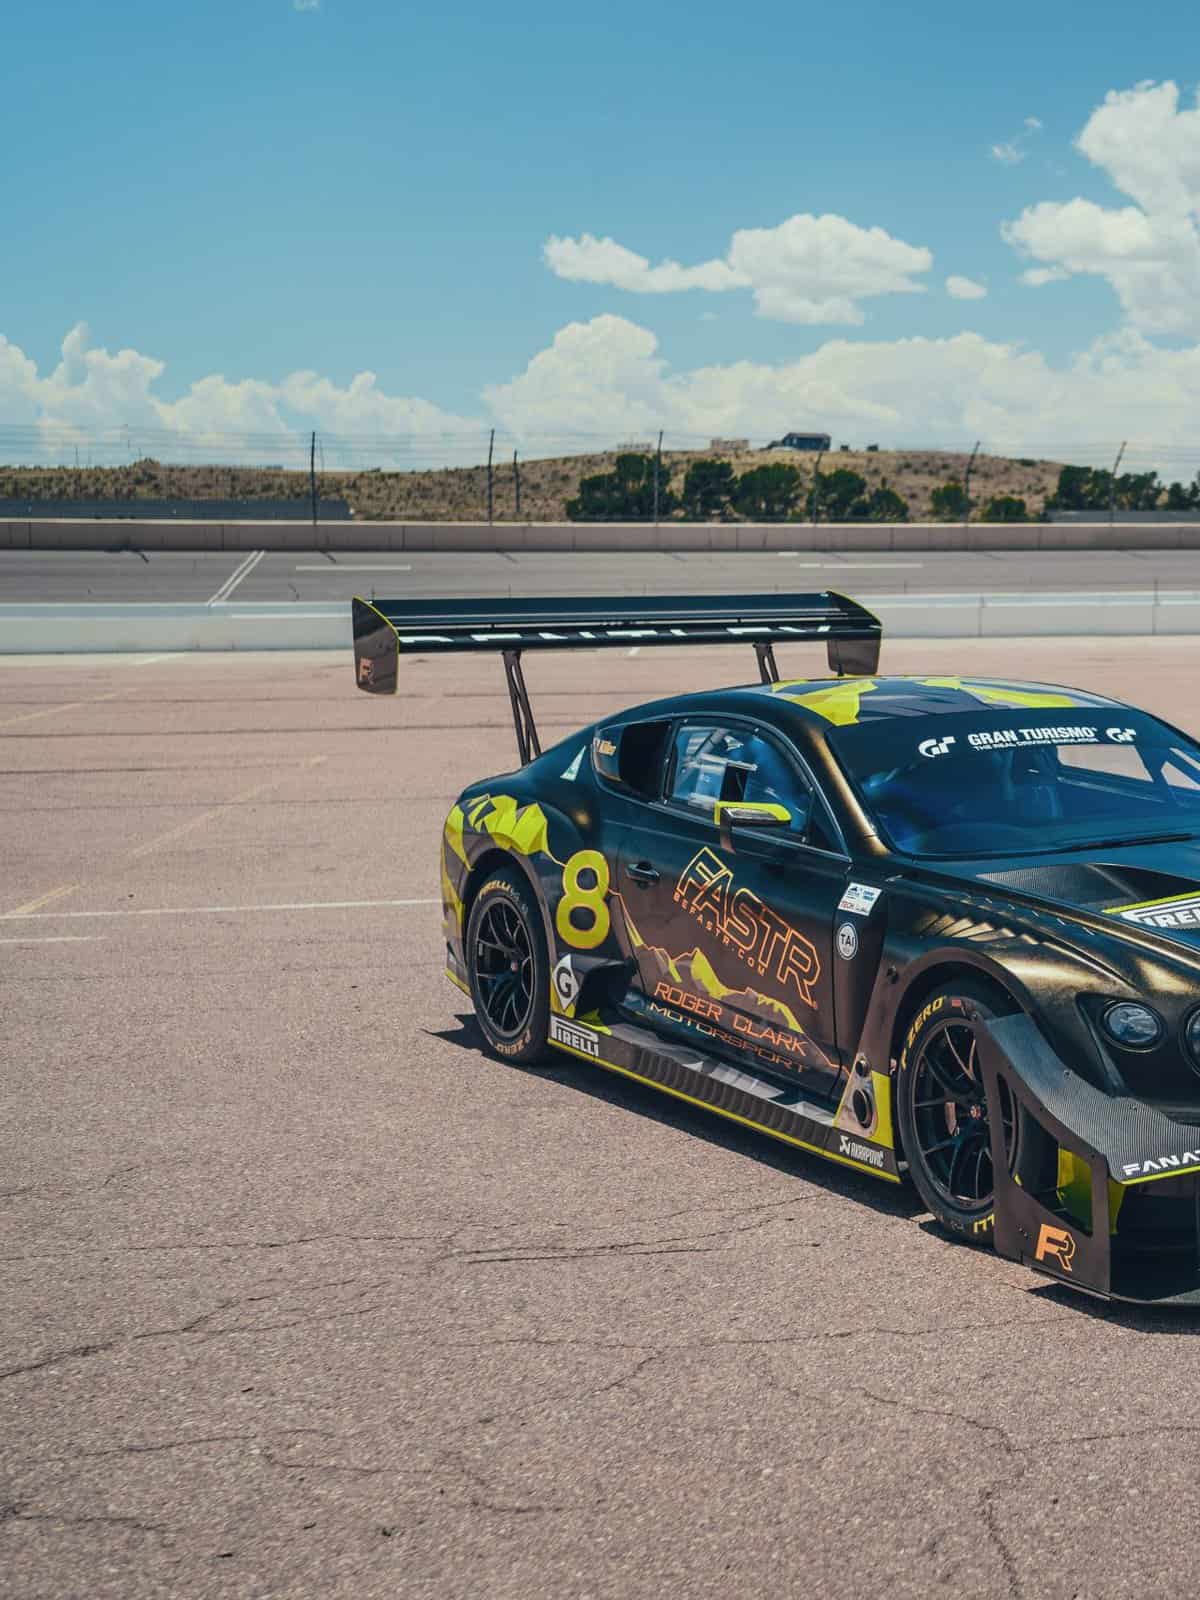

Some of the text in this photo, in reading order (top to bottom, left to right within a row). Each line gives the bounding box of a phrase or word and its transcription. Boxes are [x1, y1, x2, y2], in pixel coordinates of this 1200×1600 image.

[968, 727, 1094, 746] GRAN TURISMO
[557, 850, 609, 949] 8
[676, 846, 820, 1008] FASTR
[556, 966, 572, 998] G
[550, 1015, 599, 1057] PIRELLI
[650, 1001, 809, 1073] MOTORSPORT
[654, 981, 809, 1057] ROGER CLARK
[911, 995, 951, 1049] ZERO
